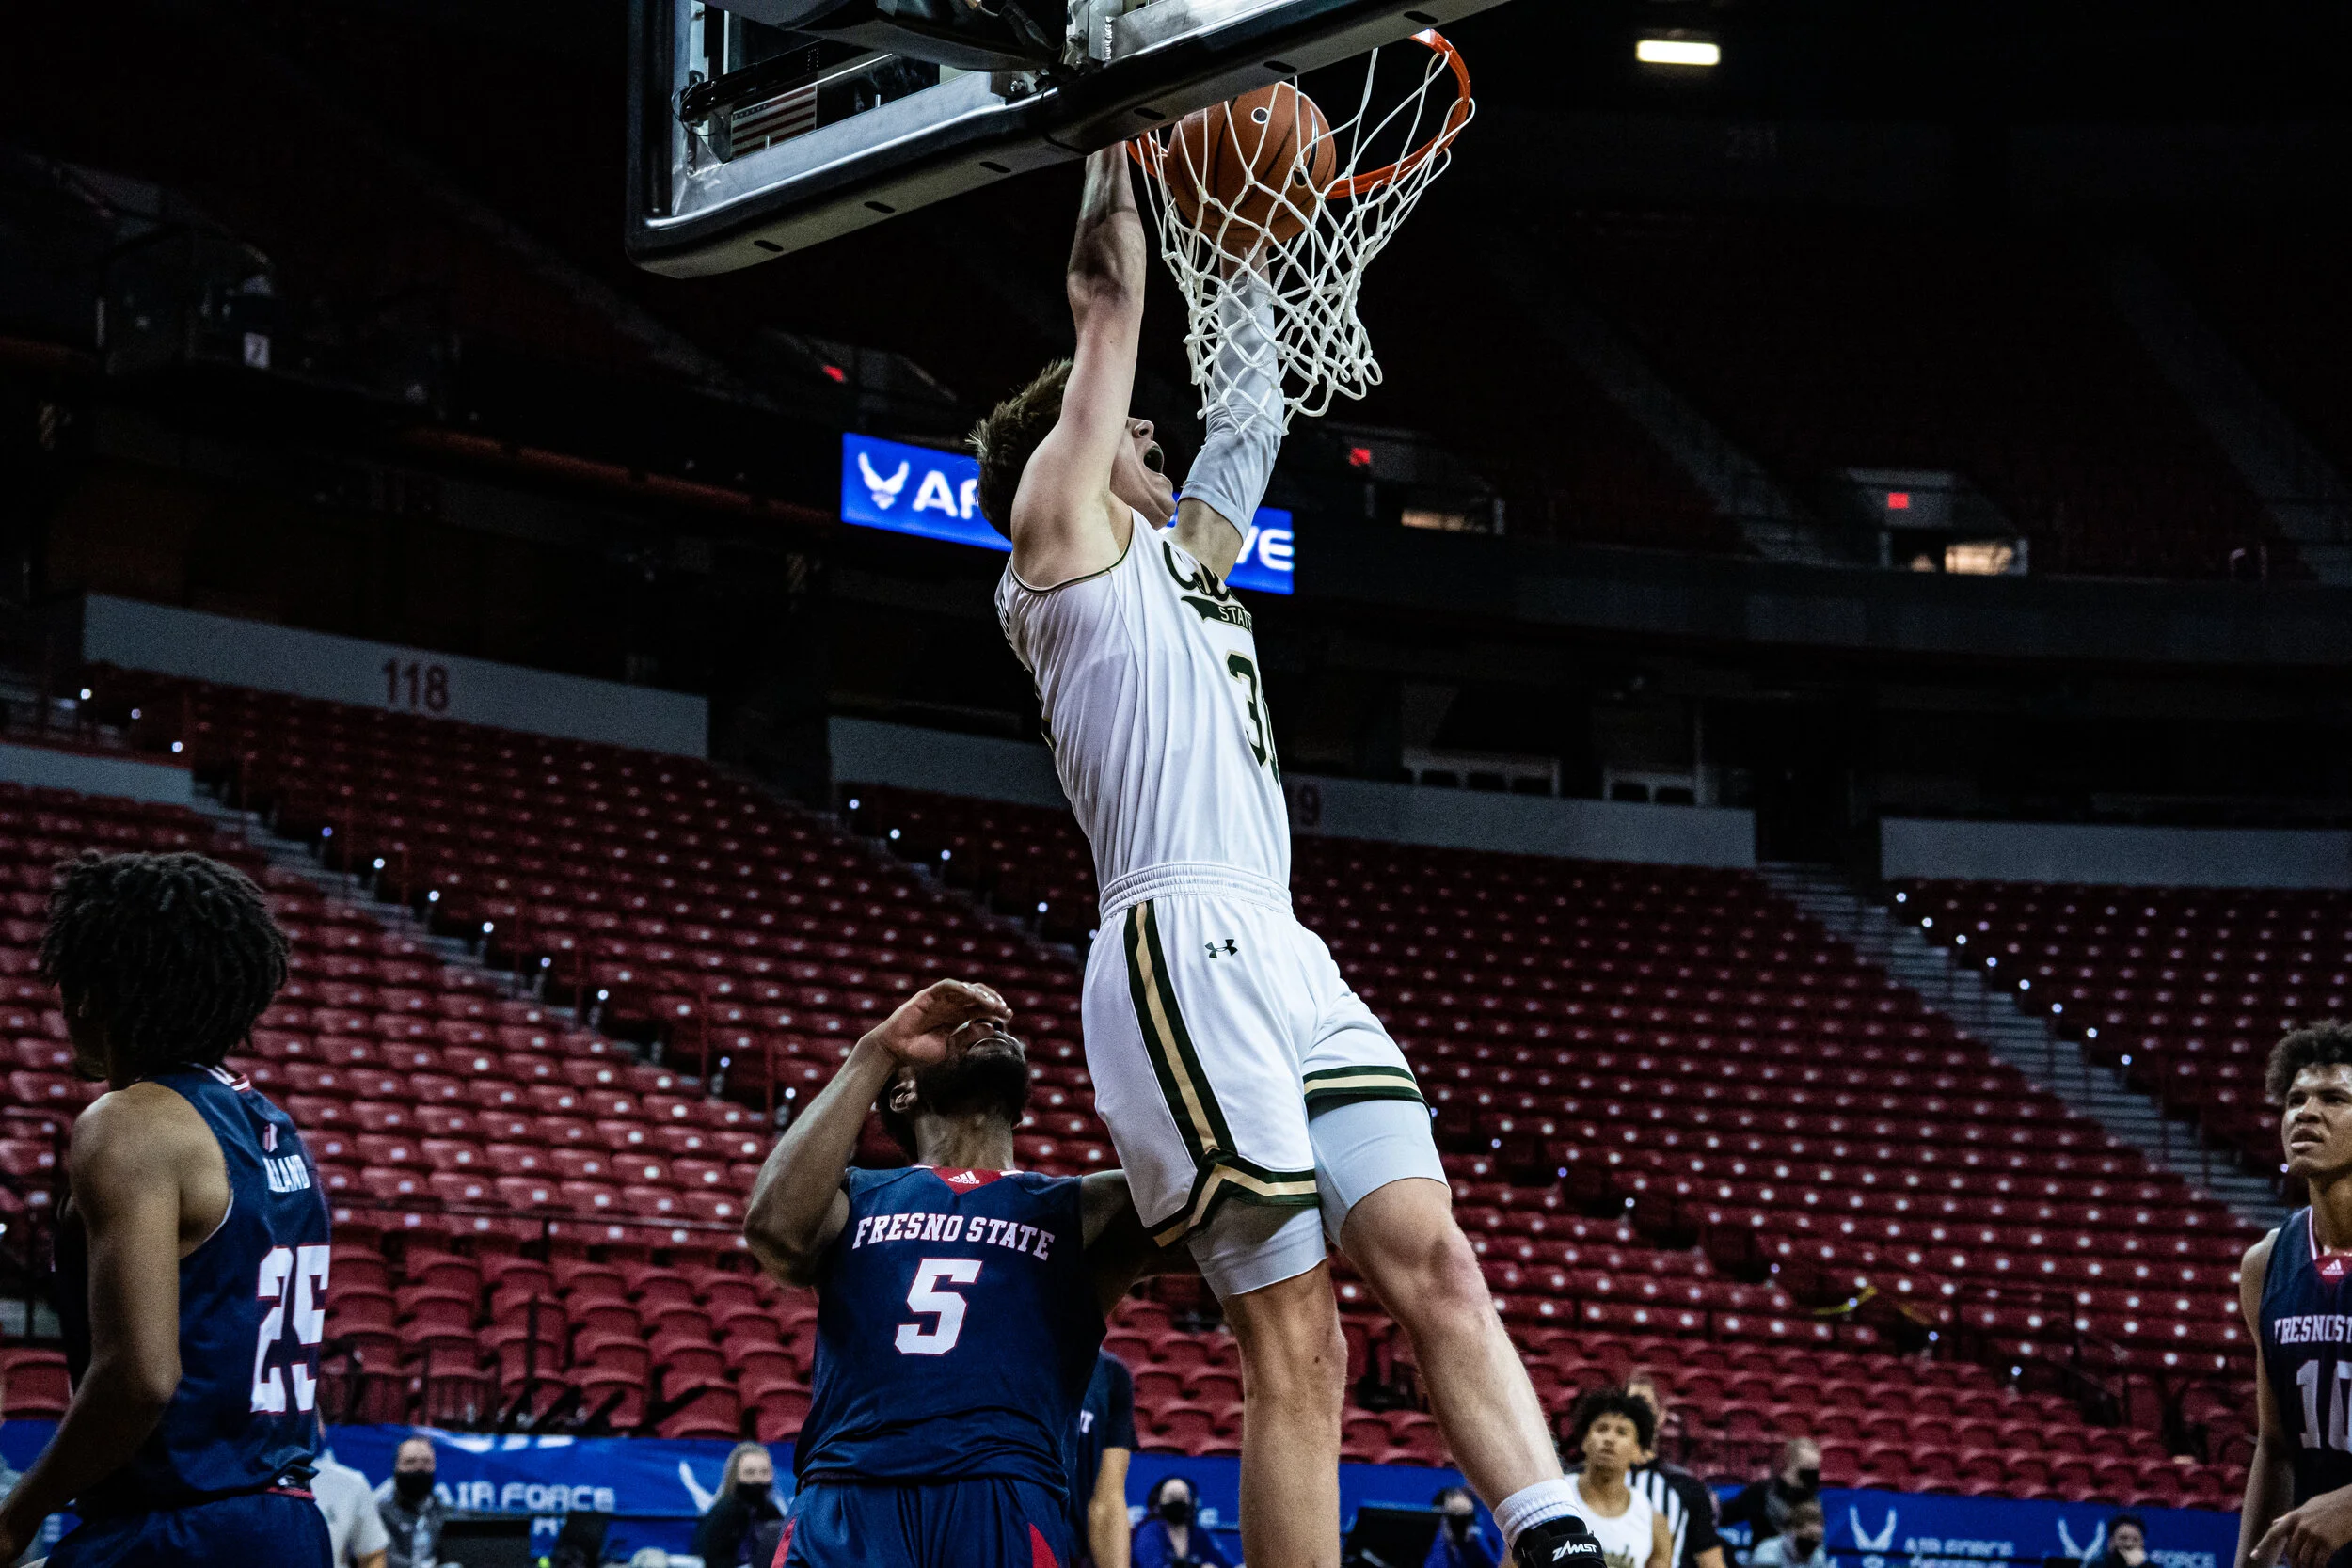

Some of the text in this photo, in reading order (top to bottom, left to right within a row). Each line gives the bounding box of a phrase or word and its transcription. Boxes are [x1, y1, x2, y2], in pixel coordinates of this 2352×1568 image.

[381, 658, 449, 712] 118
[1225, 649, 1280, 793] 3
[851, 1212, 1056, 1262] FRESNO STATE
[248, 1243, 331, 1415] 25
[894, 1257, 984, 1357] 5
[2296, 1359, 2352, 1455] 10
[1551, 1539, 1597, 1562] ZAMST
